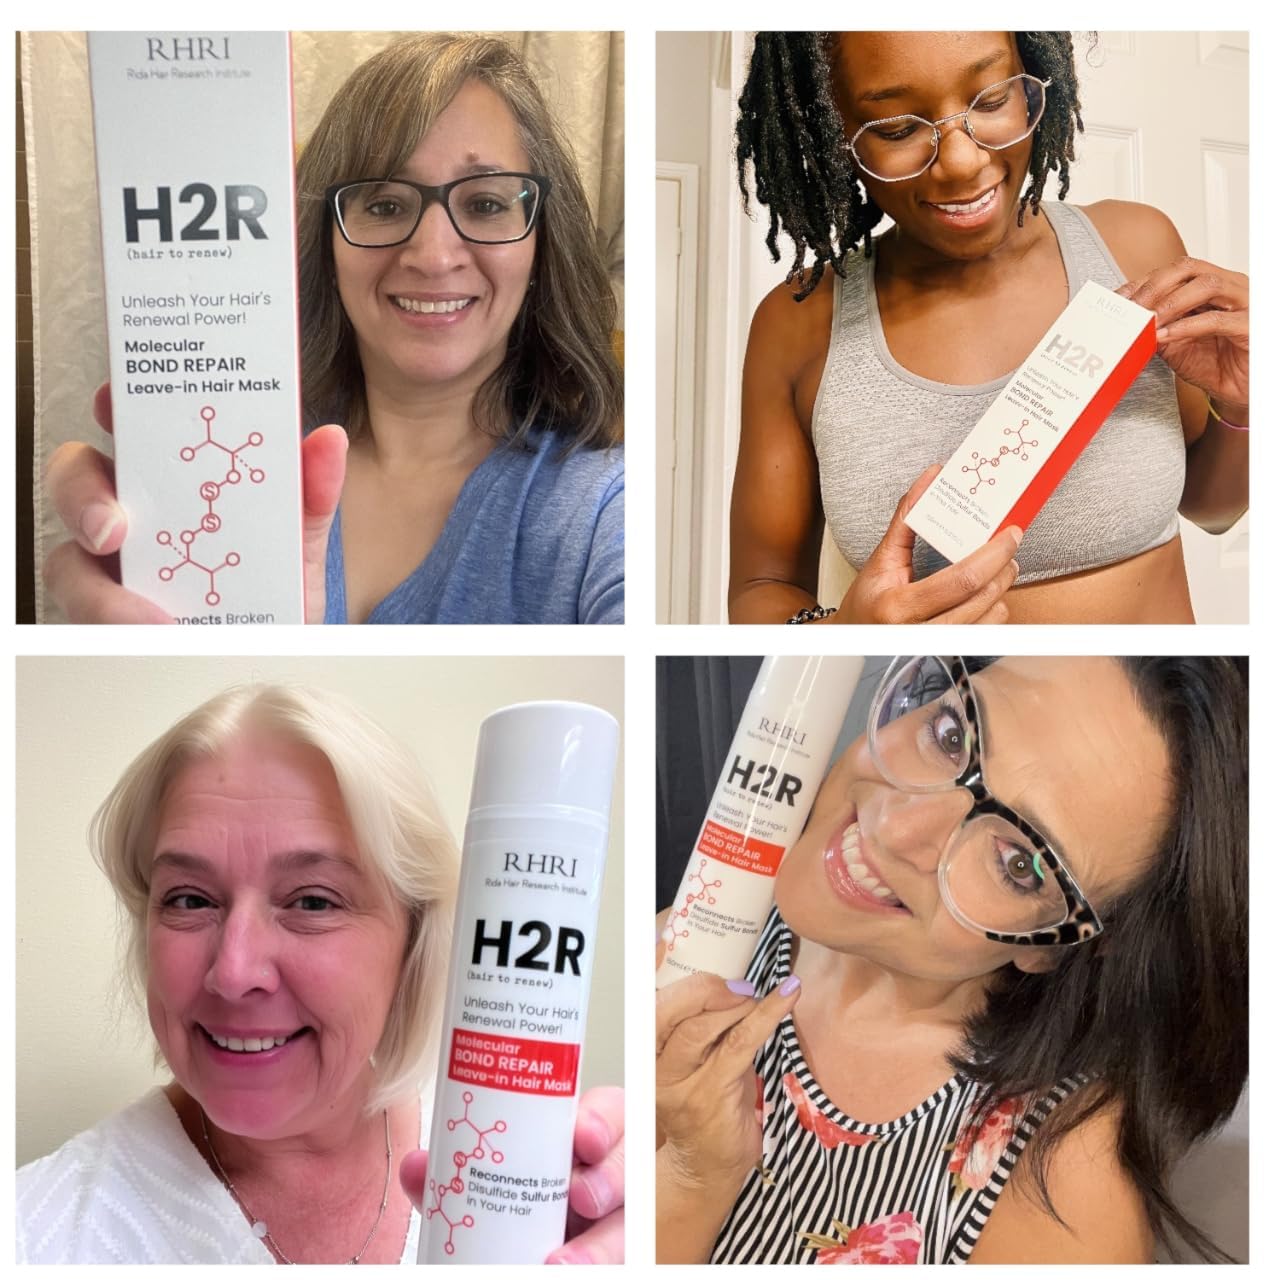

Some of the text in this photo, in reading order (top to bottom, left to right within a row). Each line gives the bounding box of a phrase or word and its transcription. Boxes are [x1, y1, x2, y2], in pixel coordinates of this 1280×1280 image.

[146, 37, 230, 61] RHRI
[123, 182, 269, 243] H2R
[127, 246, 232, 260] (hair to renew)
[122, 291, 271, 309] Unleash Your Hair's
[123, 312, 246, 327] Renewal Power!
[125, 339, 204, 353] Molecular
[126, 357, 246, 374] BOND REPAIR
[1044, 334, 1104, 380] H2R
[127, 379, 280, 394] Leave-in Hair Mask
[226, 612, 274, 624] Broken
[759, 717, 807, 746] RHRI
[727, 755, 802, 807] H2R
[504, 852, 578, 878] RHRI
[731, 854, 749, 870] Hair
[471, 919, 586, 977] H2R
[464, 996, 579, 1021] Unleash Your Hair's
[462, 1011, 562, 1035] Renewal Power!
[456, 1034, 521, 1055] Molecular
[454, 1051, 554, 1075] BOND REPAIR
[512, 1075, 541, 1090] Hair
[470, 1167, 538, 1187] Reconnects
[521, 1192, 550, 1202] Sulfur
